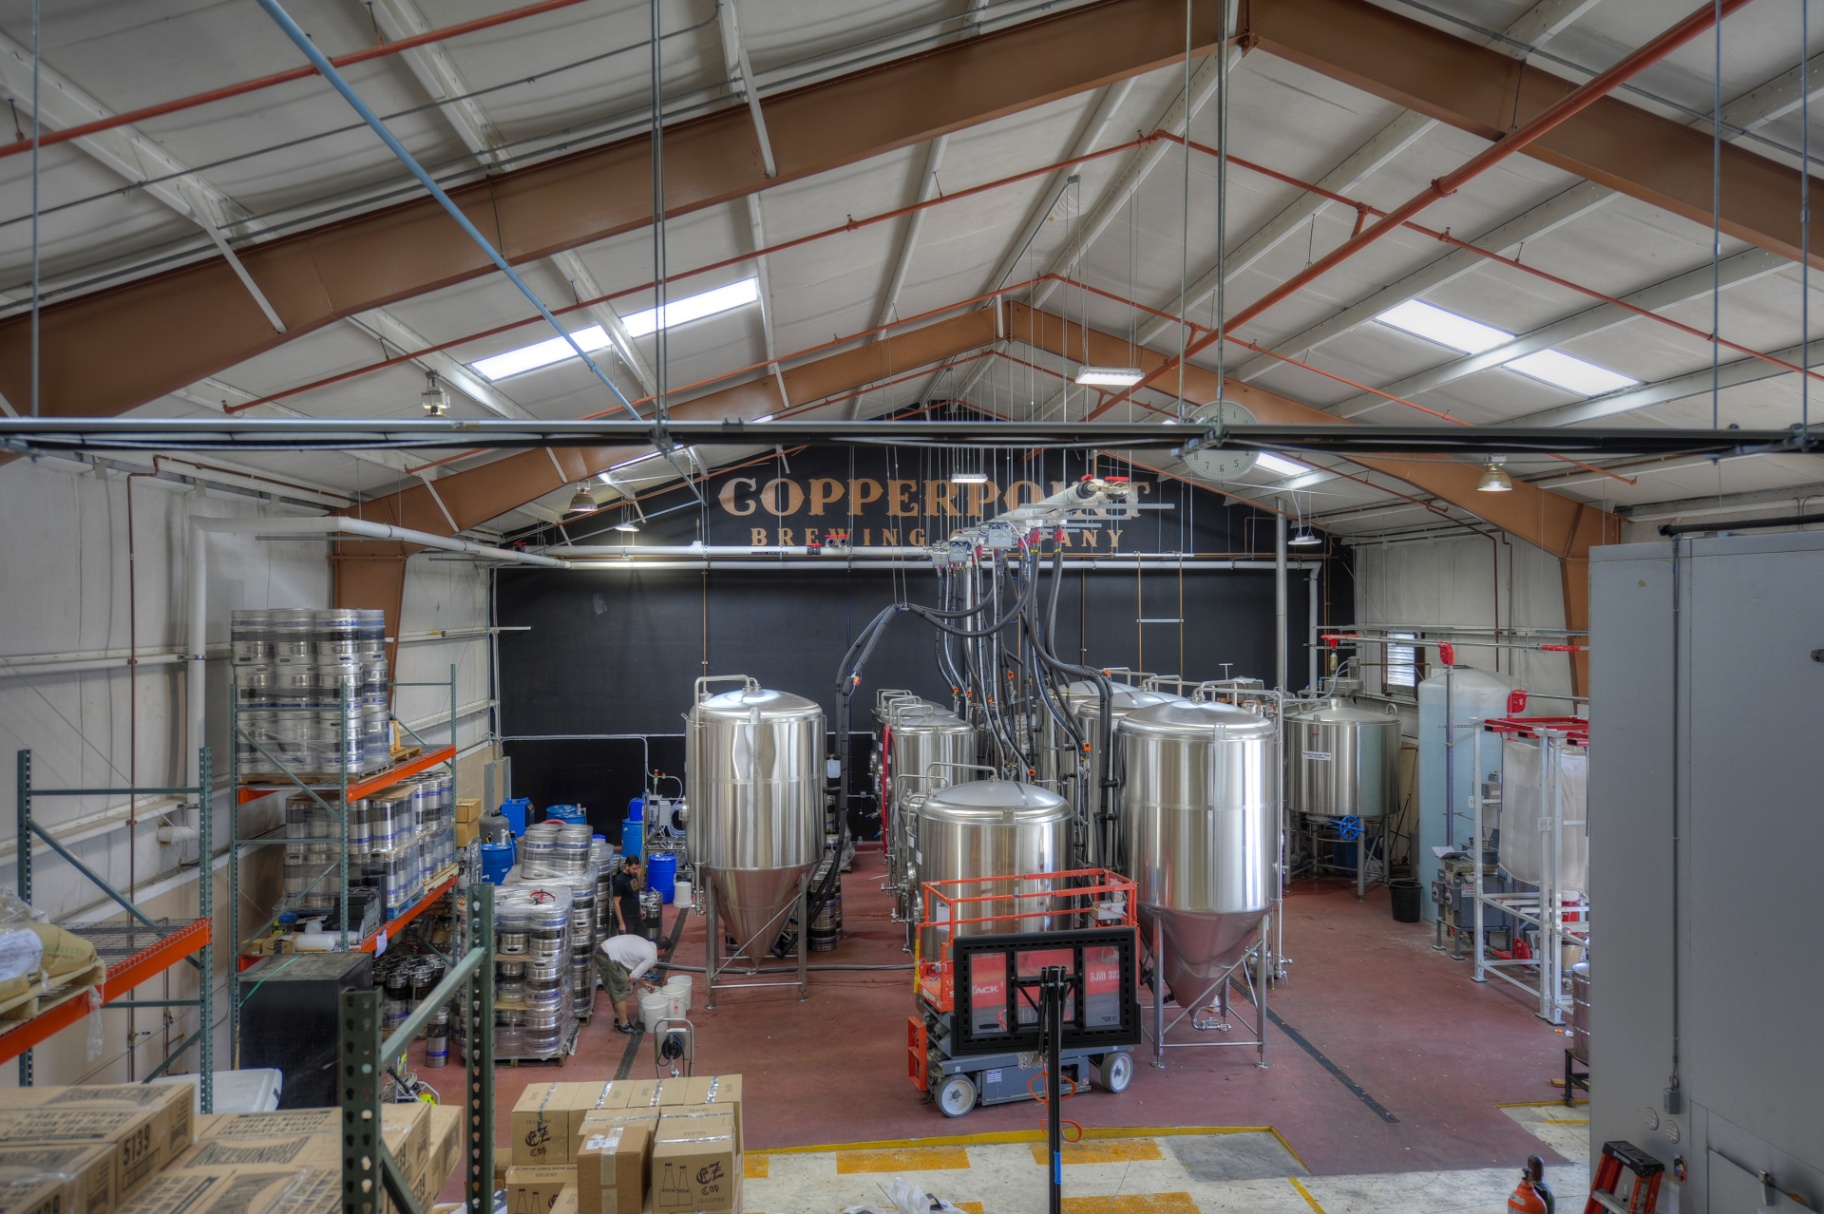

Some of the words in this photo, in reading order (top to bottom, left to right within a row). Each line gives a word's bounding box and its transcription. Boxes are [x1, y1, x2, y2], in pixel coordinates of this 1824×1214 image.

[1193, 452, 1198, 460] 8
[1220, 464, 1224, 472] 6
[1234, 460, 1239, 468] 5
[122, 1124, 151, 1167] 5139
[696, 1161, 725, 1185] EZ
